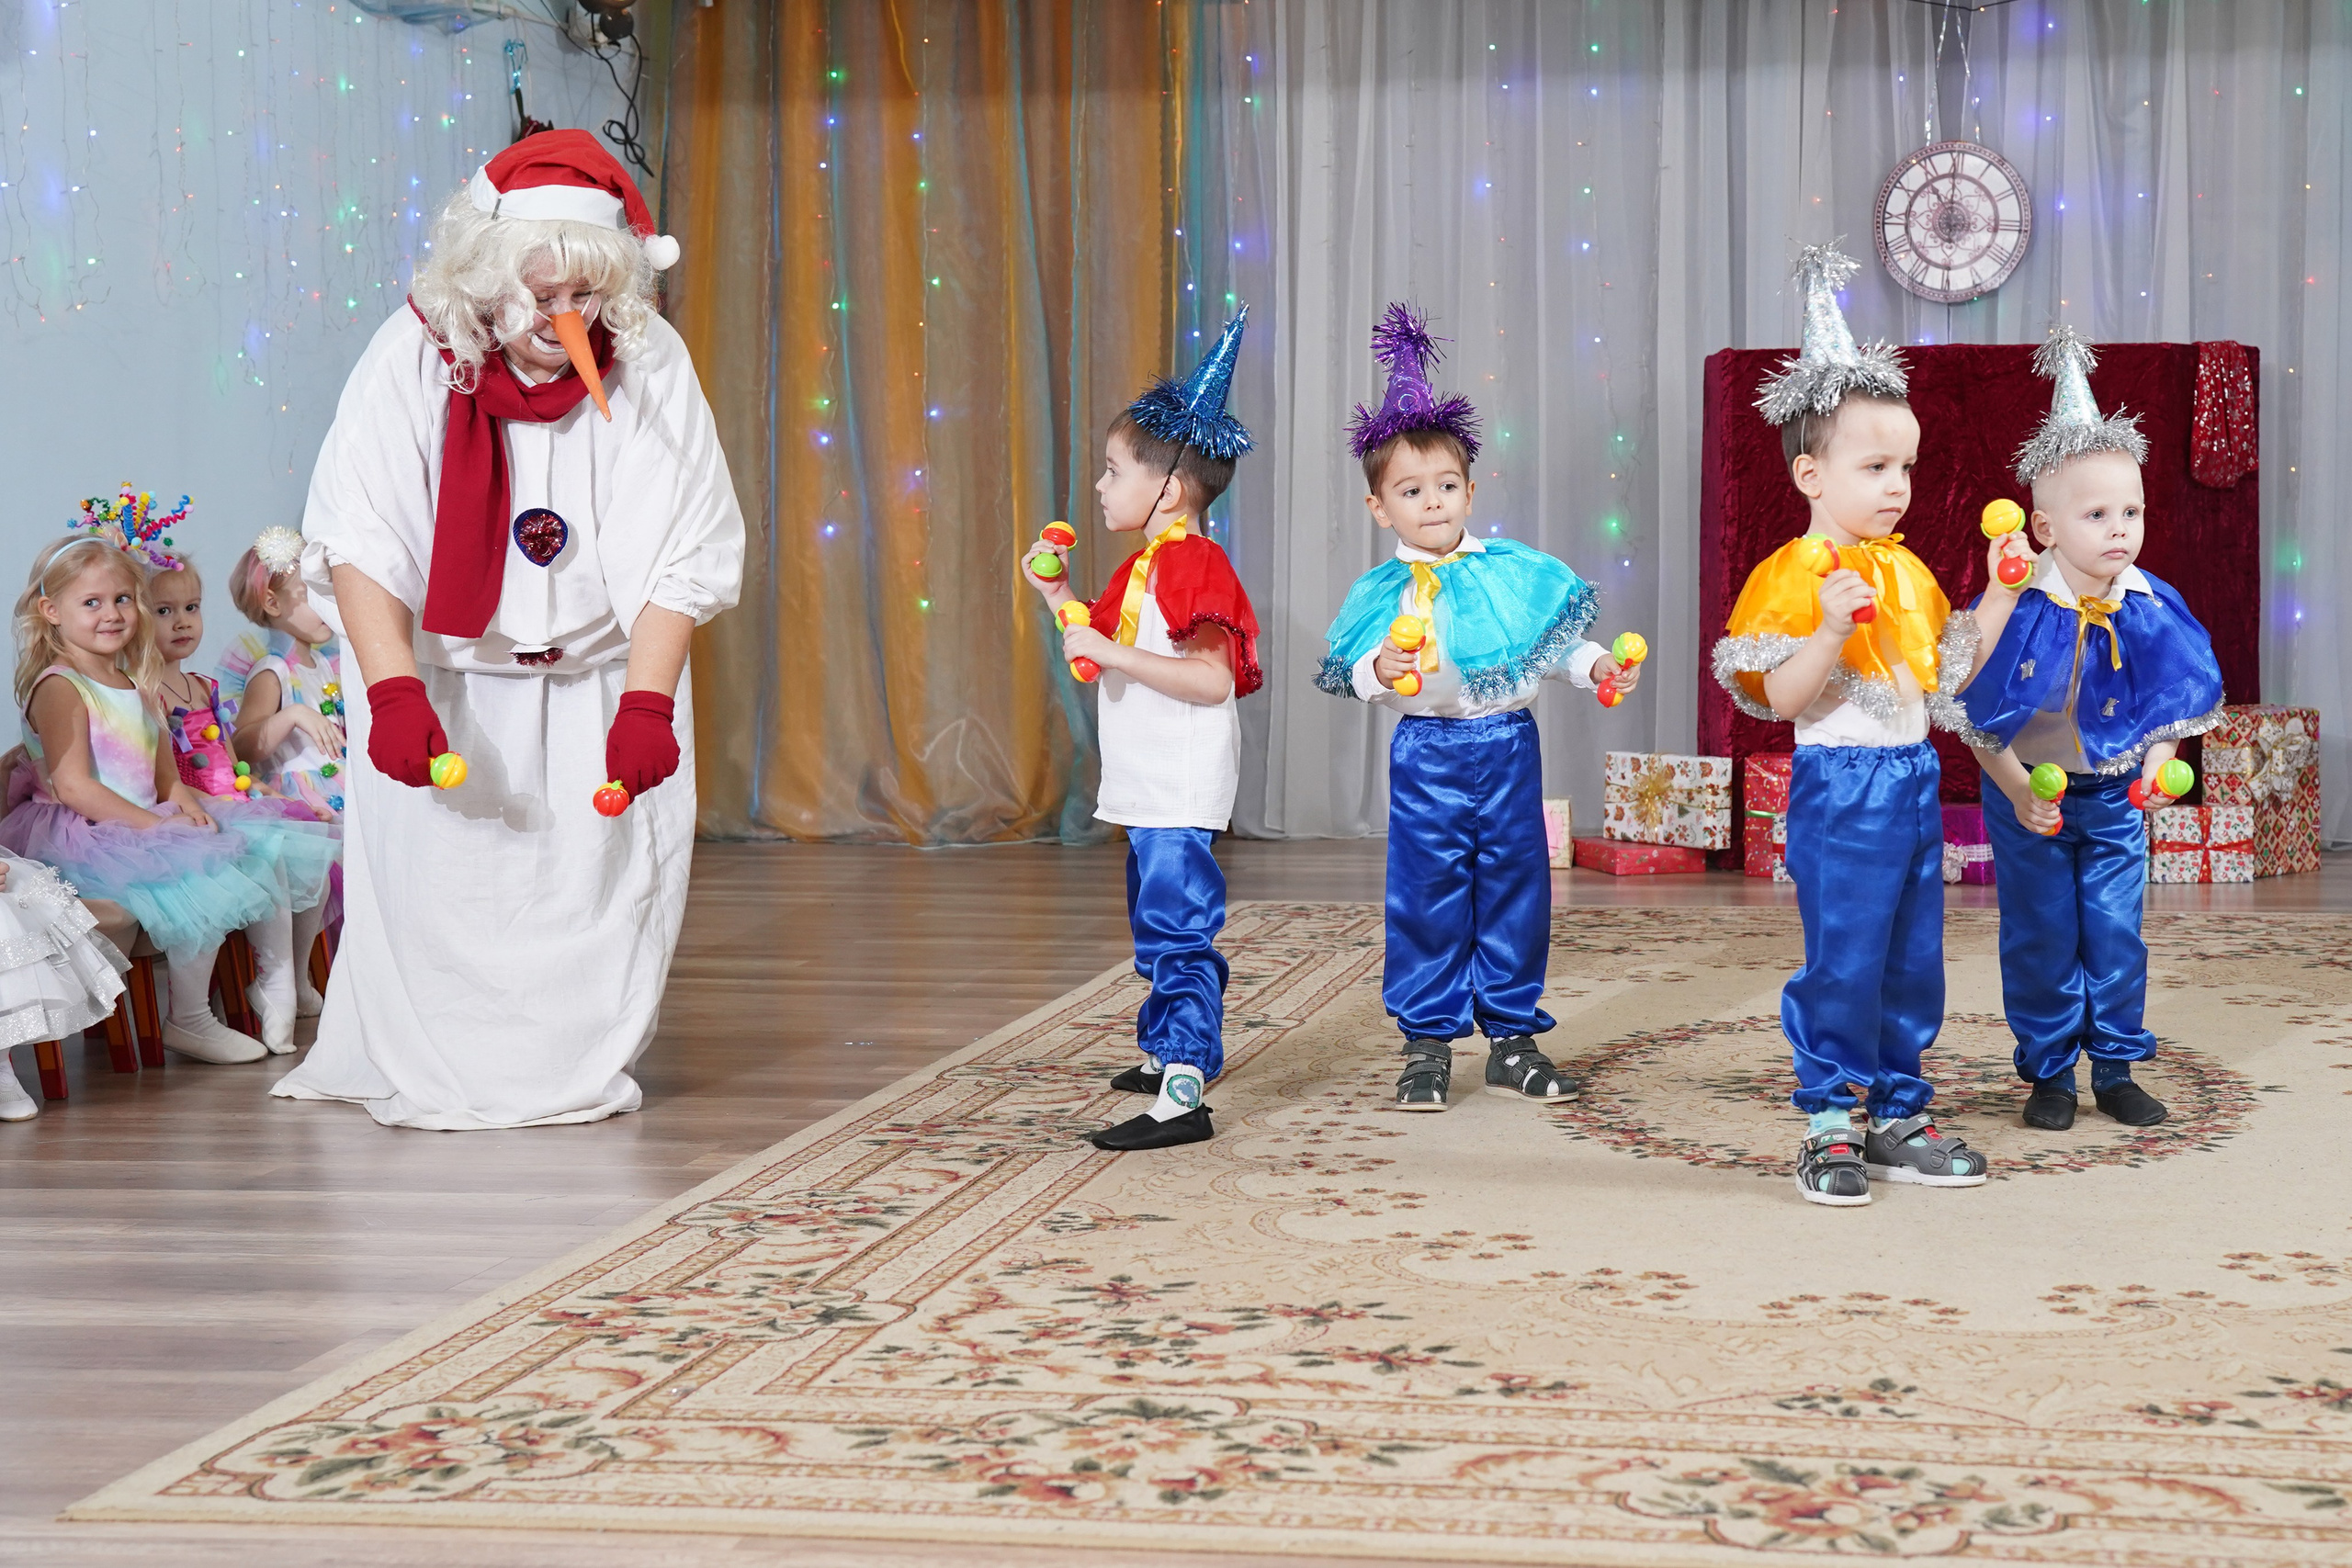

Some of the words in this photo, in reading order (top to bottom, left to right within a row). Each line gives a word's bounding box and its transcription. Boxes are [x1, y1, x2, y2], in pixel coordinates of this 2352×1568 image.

[1894, 180, 1917, 198] X
[1993, 186, 2016, 203] II
[1883, 211, 1907, 226] IX
[1998, 219, 2021, 231] III
